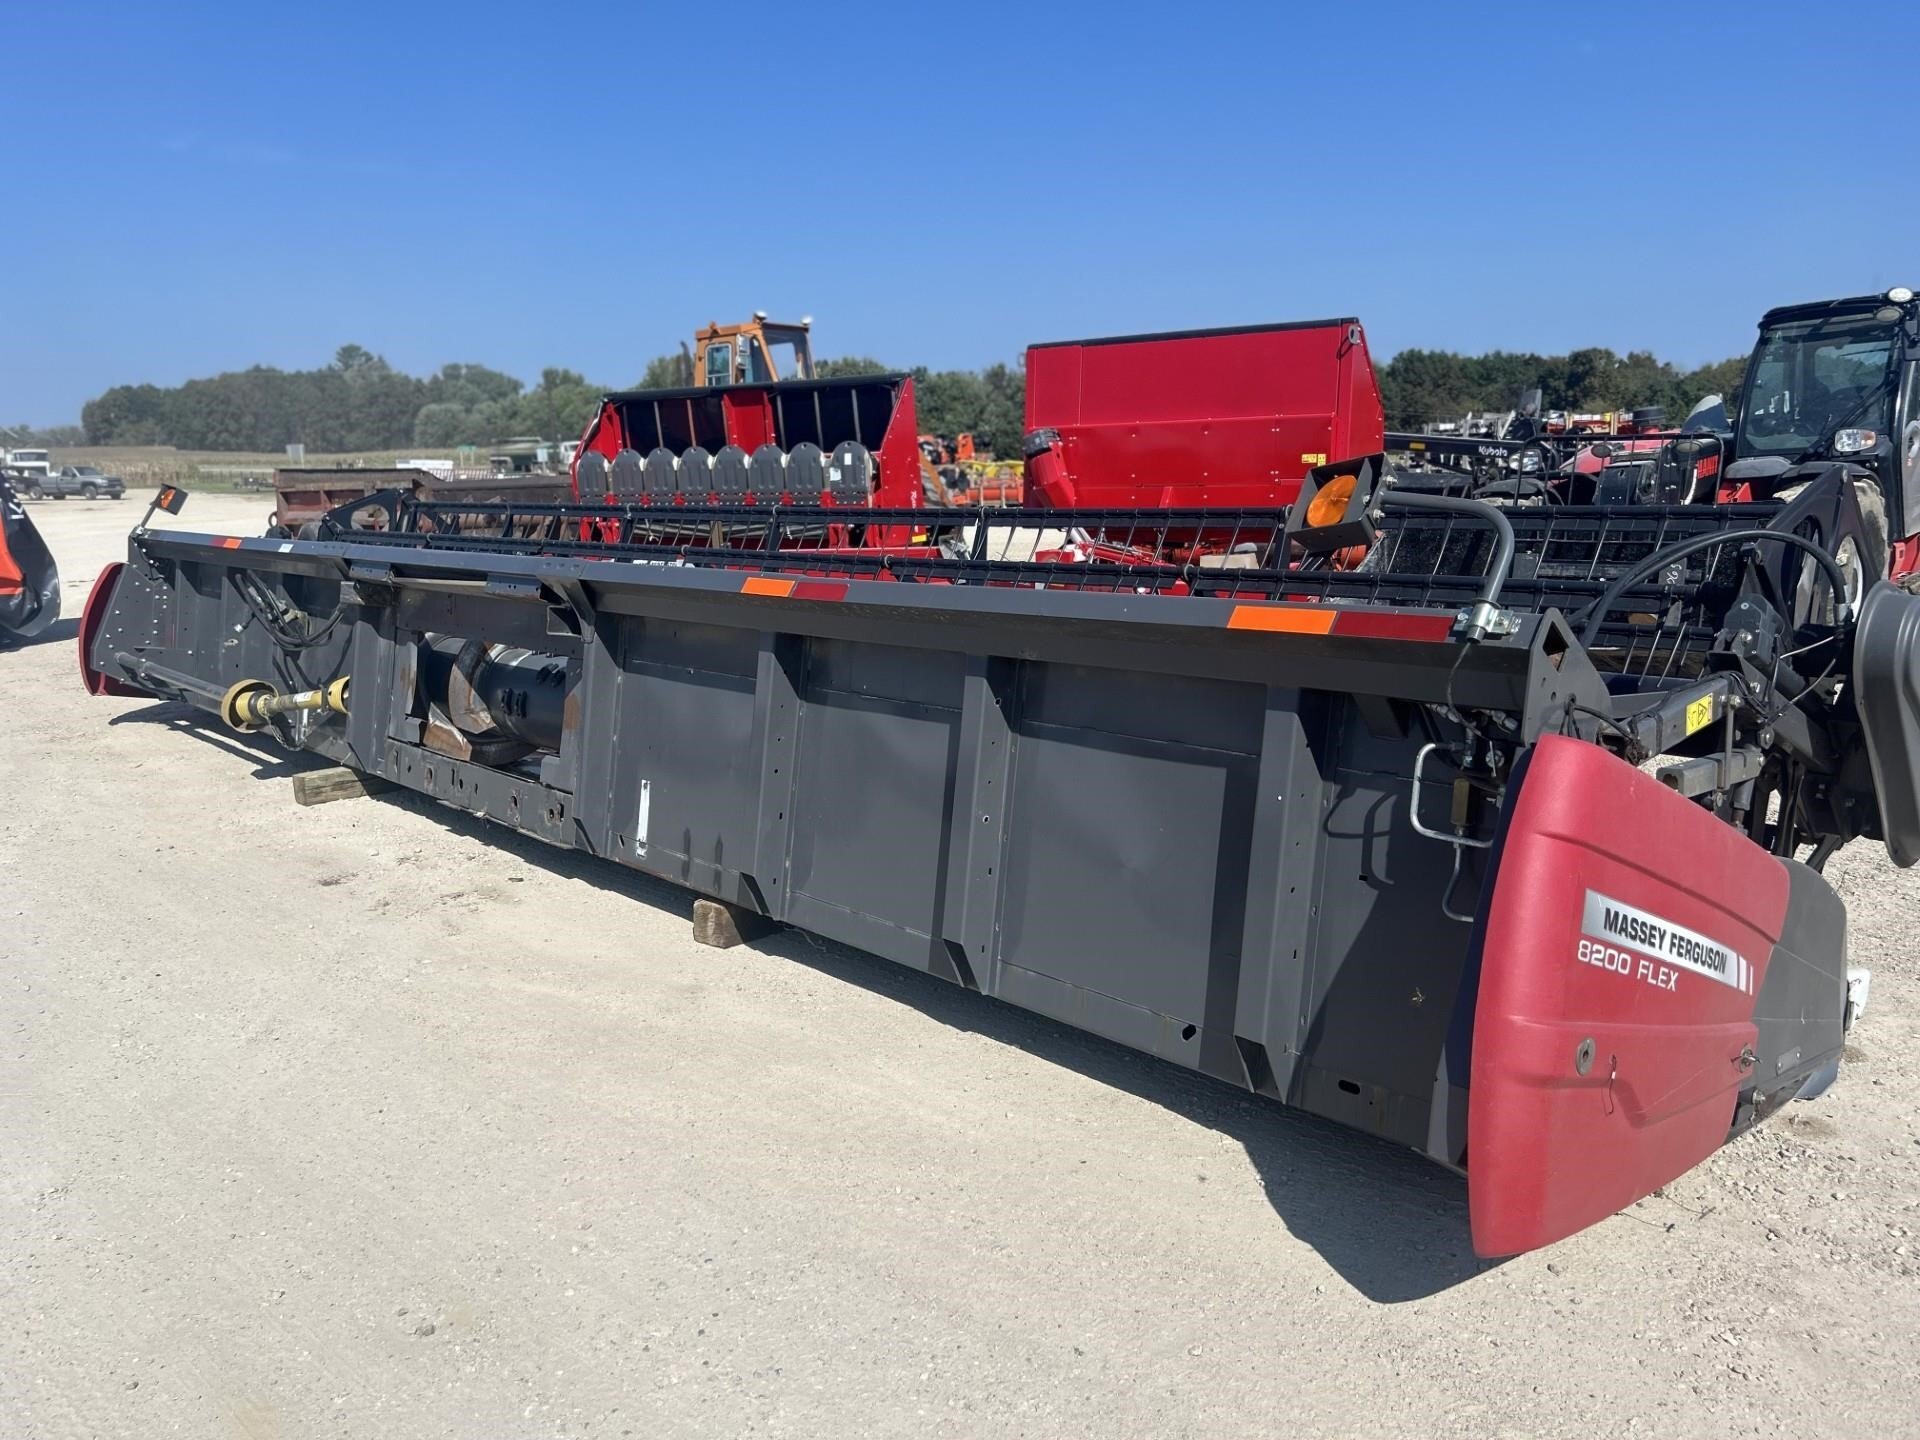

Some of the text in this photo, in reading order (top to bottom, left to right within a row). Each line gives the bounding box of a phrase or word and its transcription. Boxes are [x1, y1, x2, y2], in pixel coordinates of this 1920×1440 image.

[1577, 939, 1679, 992] 8200 FLEX
[1603, 907, 1728, 975] MASSEY FERGUSON
